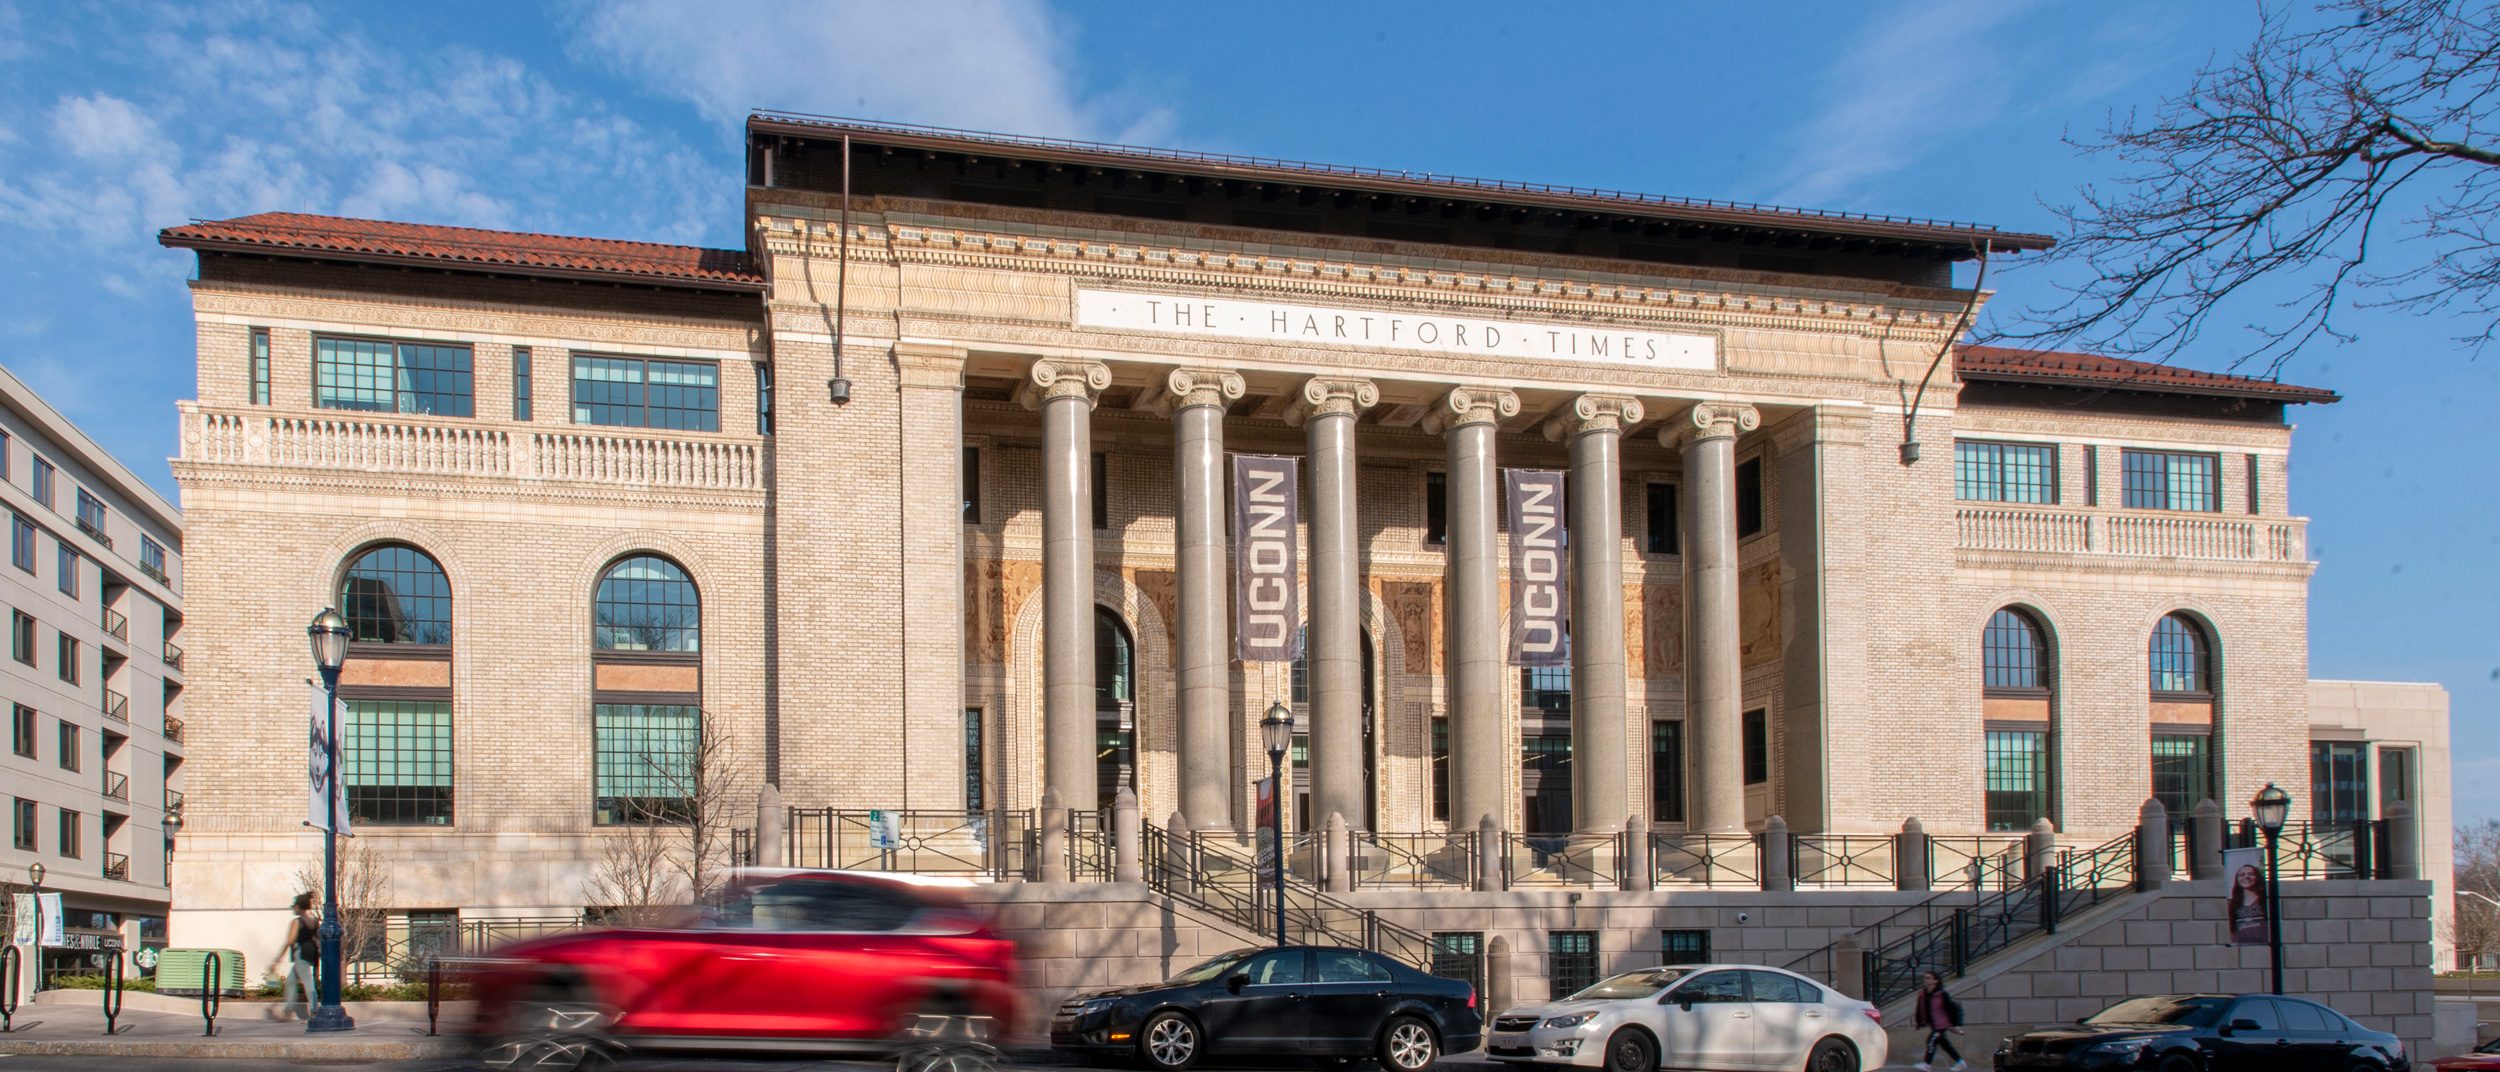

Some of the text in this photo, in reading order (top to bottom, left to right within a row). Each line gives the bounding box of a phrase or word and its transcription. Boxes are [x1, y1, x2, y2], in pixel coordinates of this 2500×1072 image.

[1147, 300, 1656, 360] THE HARTFORD TIMES
[1249, 469, 1288, 648] UCONN
[1519, 483, 1559, 653] UCONN
[873, 811, 878, 820] 2
